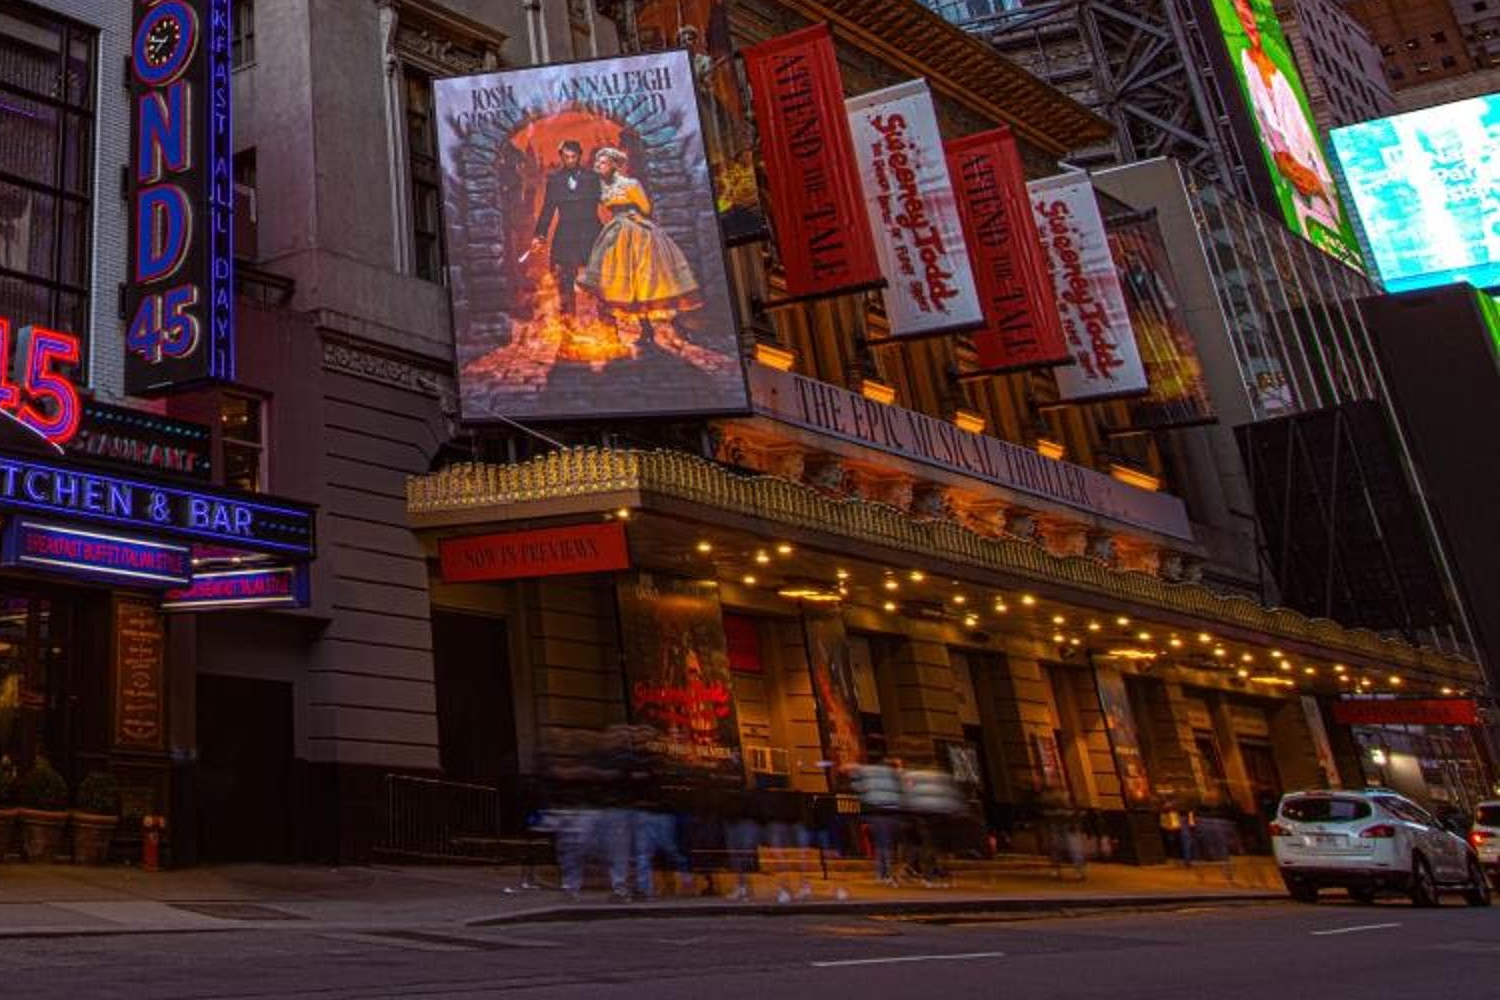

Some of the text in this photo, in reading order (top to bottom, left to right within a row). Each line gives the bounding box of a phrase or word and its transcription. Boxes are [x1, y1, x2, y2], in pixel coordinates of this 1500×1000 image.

[471, 85, 518, 112] JOSH
[557, 67, 672, 103] ANNALEIGH
[215, 157, 228, 232] ALL
[772, 54, 824, 159] ATTEND
[803, 202, 849, 281] TALE
[870, 112, 959, 314] Sweeney Todd
[962, 153, 1011, 247] ATTEND
[994, 286, 1038, 357] TALE
[1035, 200, 1095, 304] Sweeney
[1079, 301, 1125, 378] Todd
[127, 284, 199, 364] 45
[794, 375, 1092, 507] THE EPIC MUSICAL THRILLER
[148, 489, 172, 523] &
[188, 498, 254, 537] BAR
